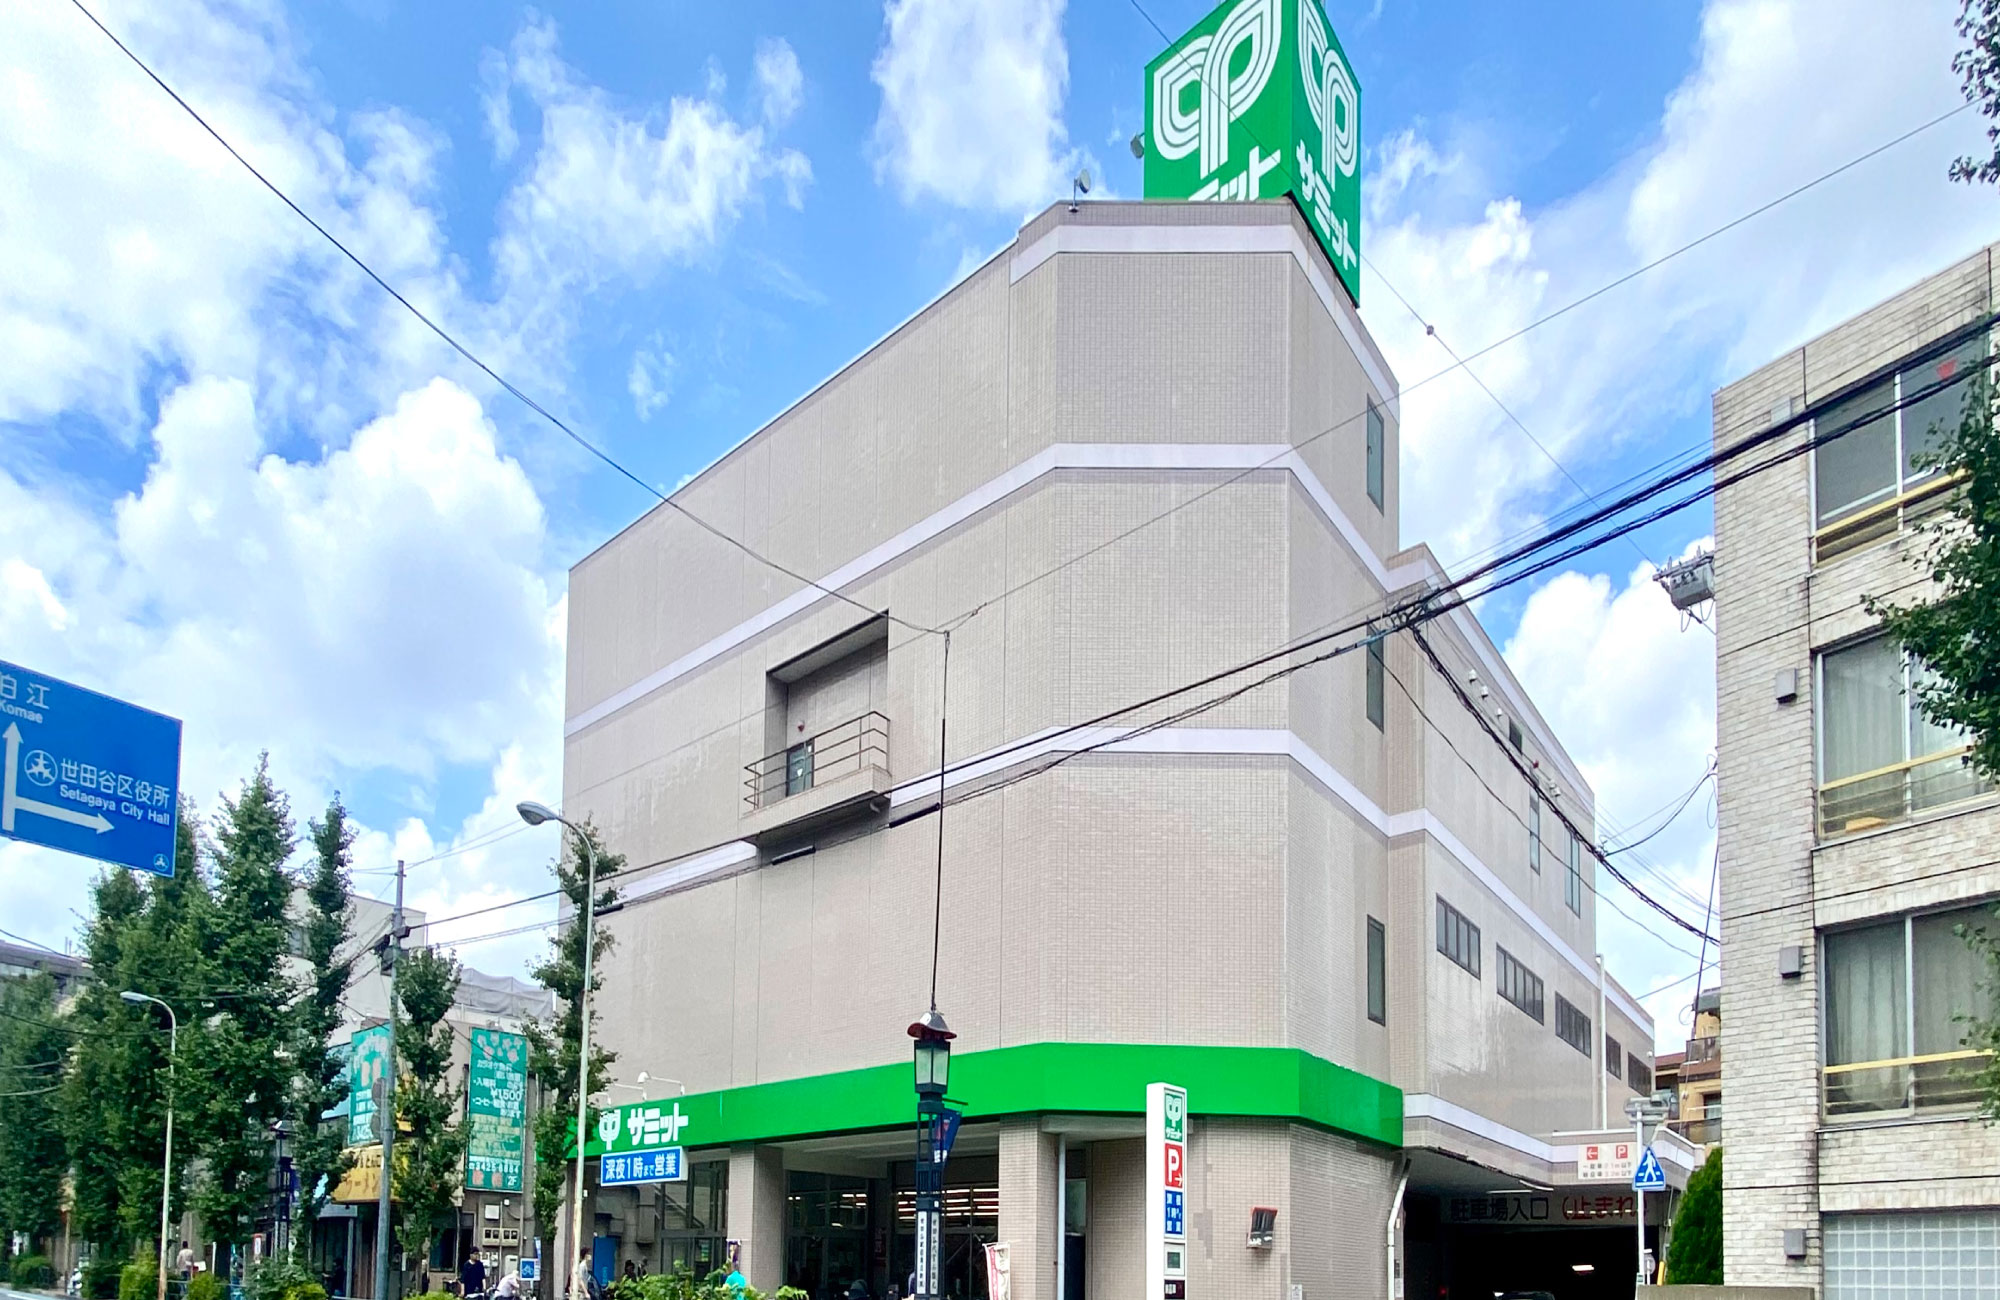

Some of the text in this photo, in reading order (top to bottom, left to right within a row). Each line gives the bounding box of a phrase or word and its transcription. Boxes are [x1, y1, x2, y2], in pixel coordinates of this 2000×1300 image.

[1296, 139, 1357, 270] サミット
[60, 758, 170, 809] 世田谷区役所
[60, 784, 170, 826] Setagaya City Hall
[627, 1102, 689, 1146] サミット
[605, 1152, 677, 1181] 深夜1時まで営業
[1167, 1148, 1179, 1183] P
[1617, 1145, 1627, 1159] P
[1450, 1196, 1549, 1222] 駐車場入口
